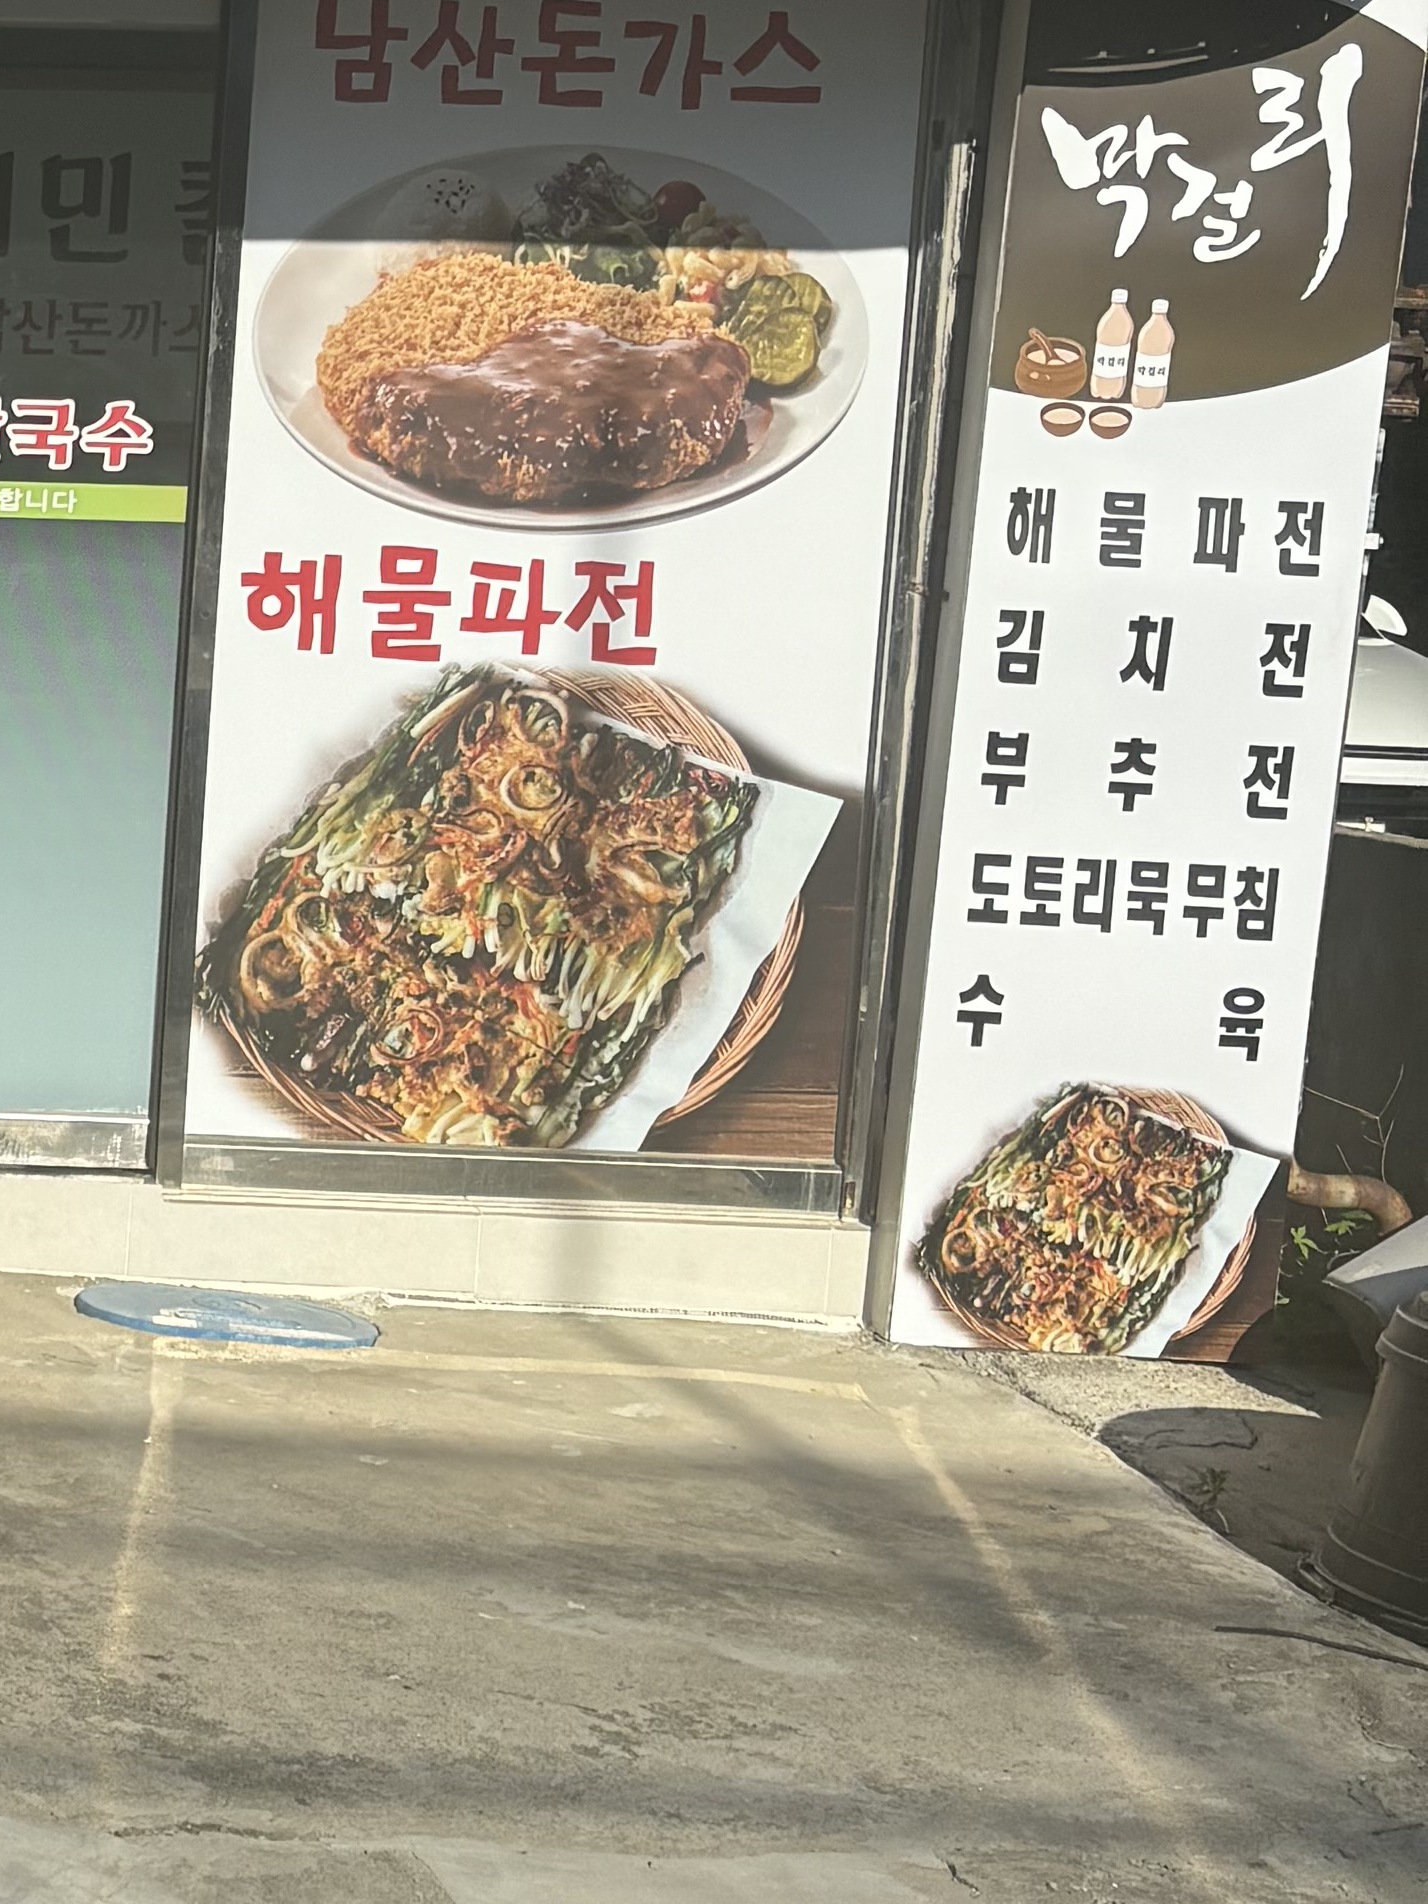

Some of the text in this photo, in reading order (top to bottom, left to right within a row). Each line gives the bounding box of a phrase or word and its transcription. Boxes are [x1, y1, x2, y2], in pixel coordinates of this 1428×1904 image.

[1040, 42, 1364, 301] 막걸리
[240, 544, 658, 666] 해물파전
[966, 852, 1280, 942] 도토리묵무침
